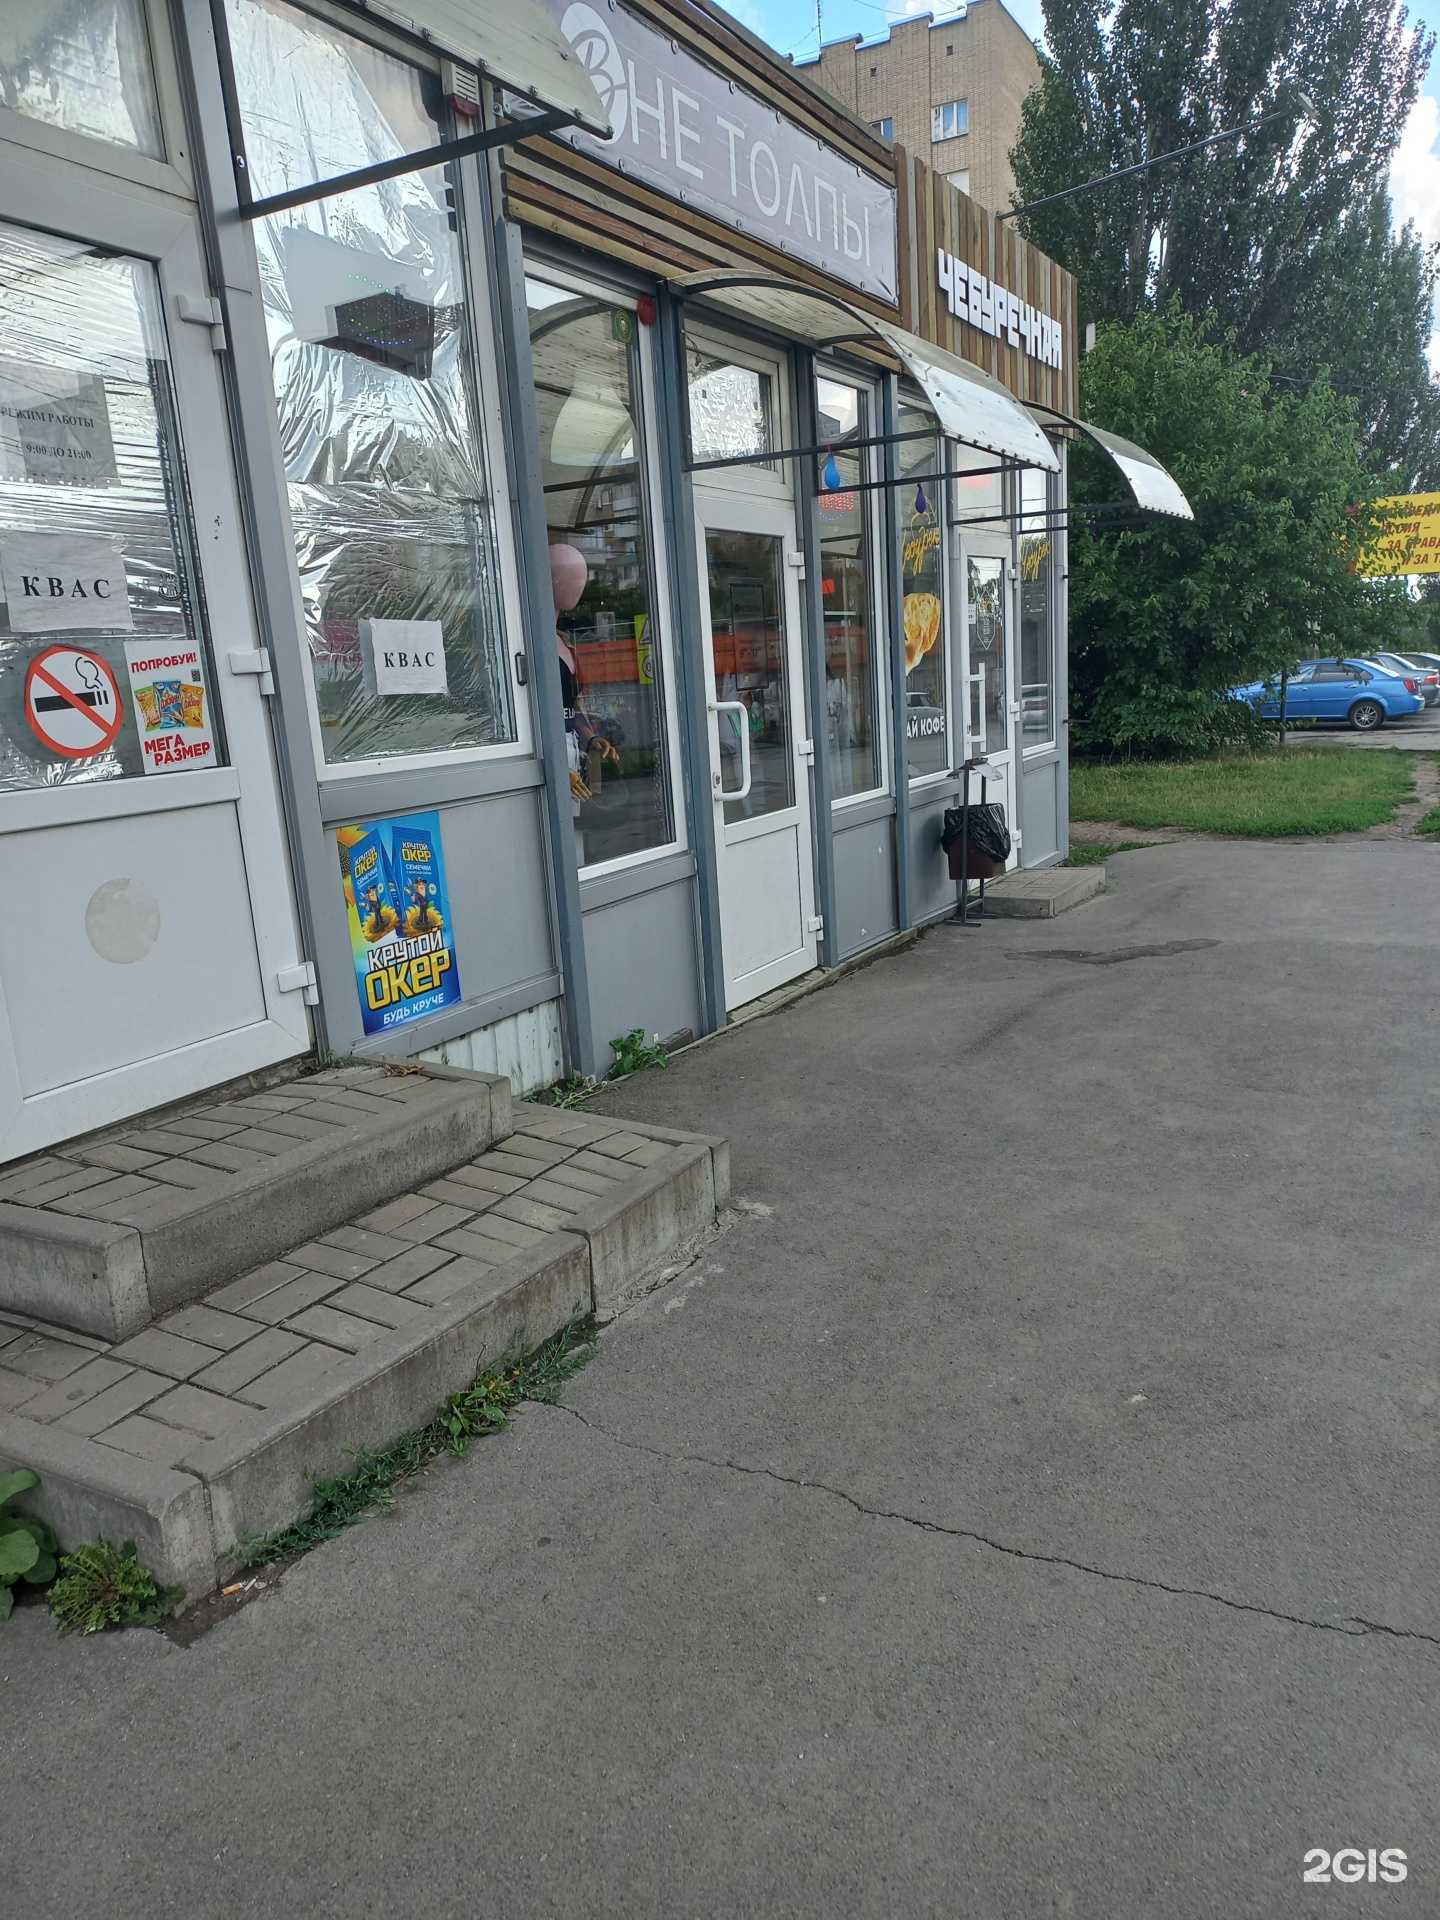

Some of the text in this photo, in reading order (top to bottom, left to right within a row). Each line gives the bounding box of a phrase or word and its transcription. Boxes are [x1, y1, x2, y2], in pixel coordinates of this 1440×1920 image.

[716, 115, 871, 267] ТОЛПЫ
[938, 247, 1063, 371] ЧЕБУРЕЧНАЯ
[48, 412, 94, 428] РАБОТЫ
[50, 446, 65, 458] ДО
[20, 575, 111, 599] КВАС
[131, 652, 197, 673] ПОПРОБУЙ!
[383, 651, 435, 668] КВАС
[907, 715, 944, 738] АЙ КОФЕ
[144, 734, 185, 754] МЕГА
[154, 742, 211, 766] РАЗМЕР
[368, 927, 443, 972] КРУТОЙ
[365, 948, 451, 1011] ОКЕР
[383, 993, 444, 1025] БУДЬ КРУЧЕ
